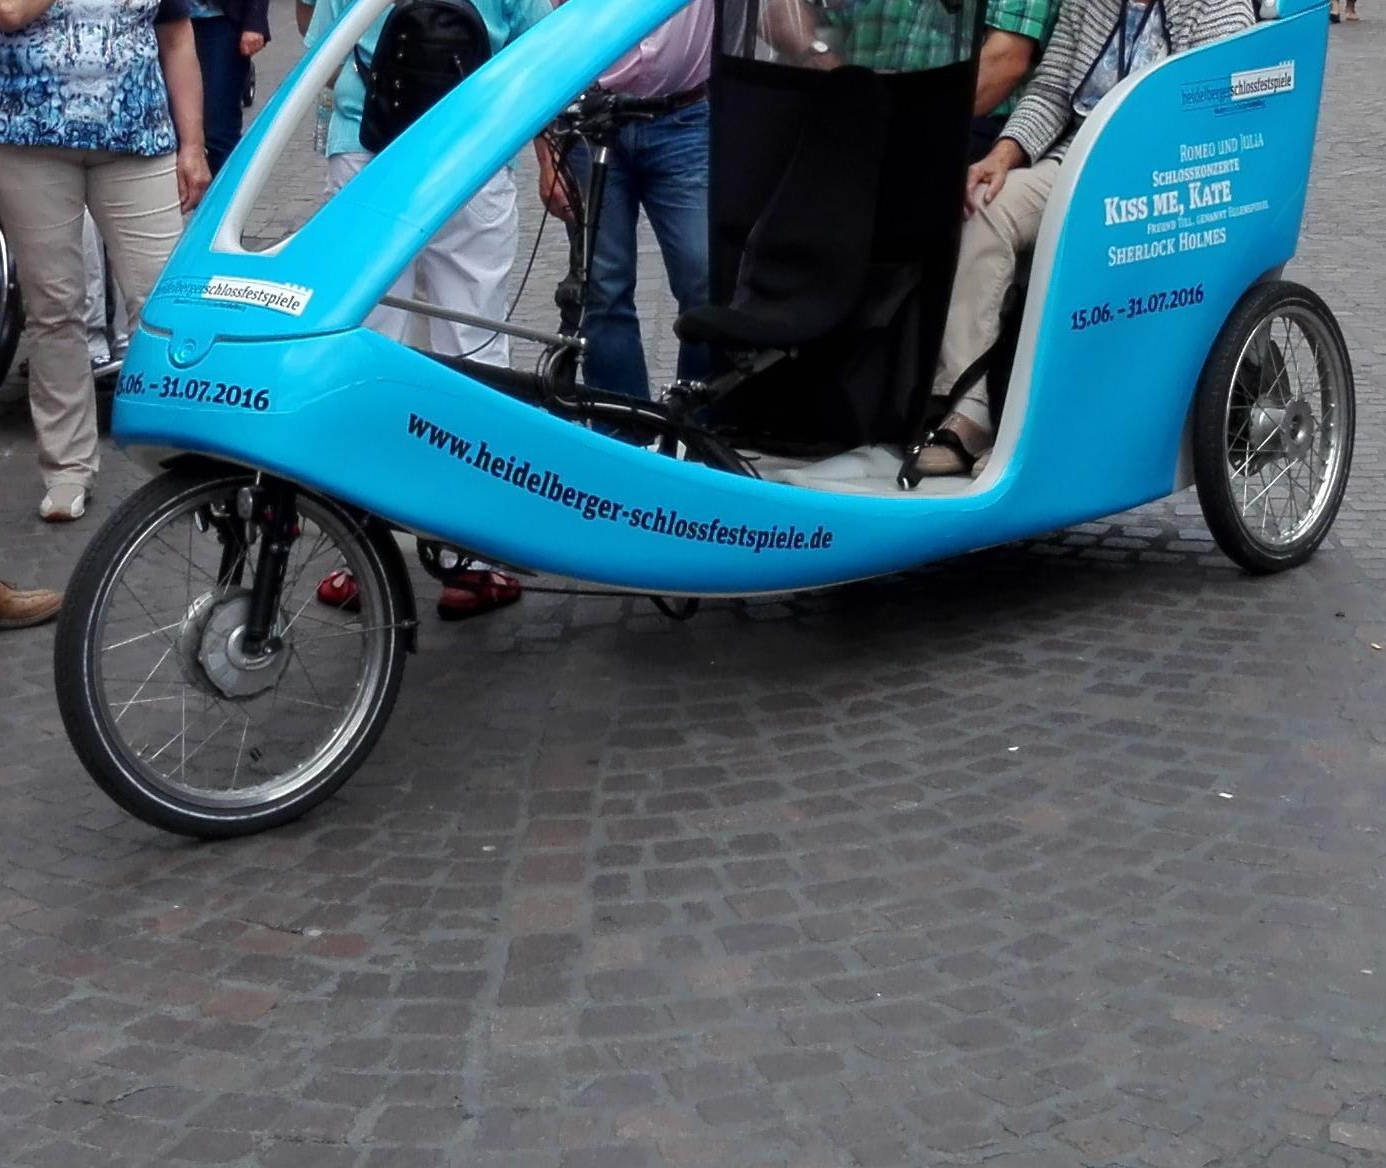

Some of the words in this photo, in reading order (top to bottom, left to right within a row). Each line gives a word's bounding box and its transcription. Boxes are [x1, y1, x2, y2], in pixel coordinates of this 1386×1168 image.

[1103, 195, 1149, 226] KISS
[1152, 190, 1185, 217] ME,
[1188, 179, 1232, 210] KATE
[1107, 237, 1176, 268] SHERLOCK
[1178, 227, 1227, 253] HOLMES
[1070, 302, 1114, 331] 15.06.
[115, 371, 146, 396] 5.06.
[407, 412, 833, 553] www.heidelberger-schlossfestspiele.de
